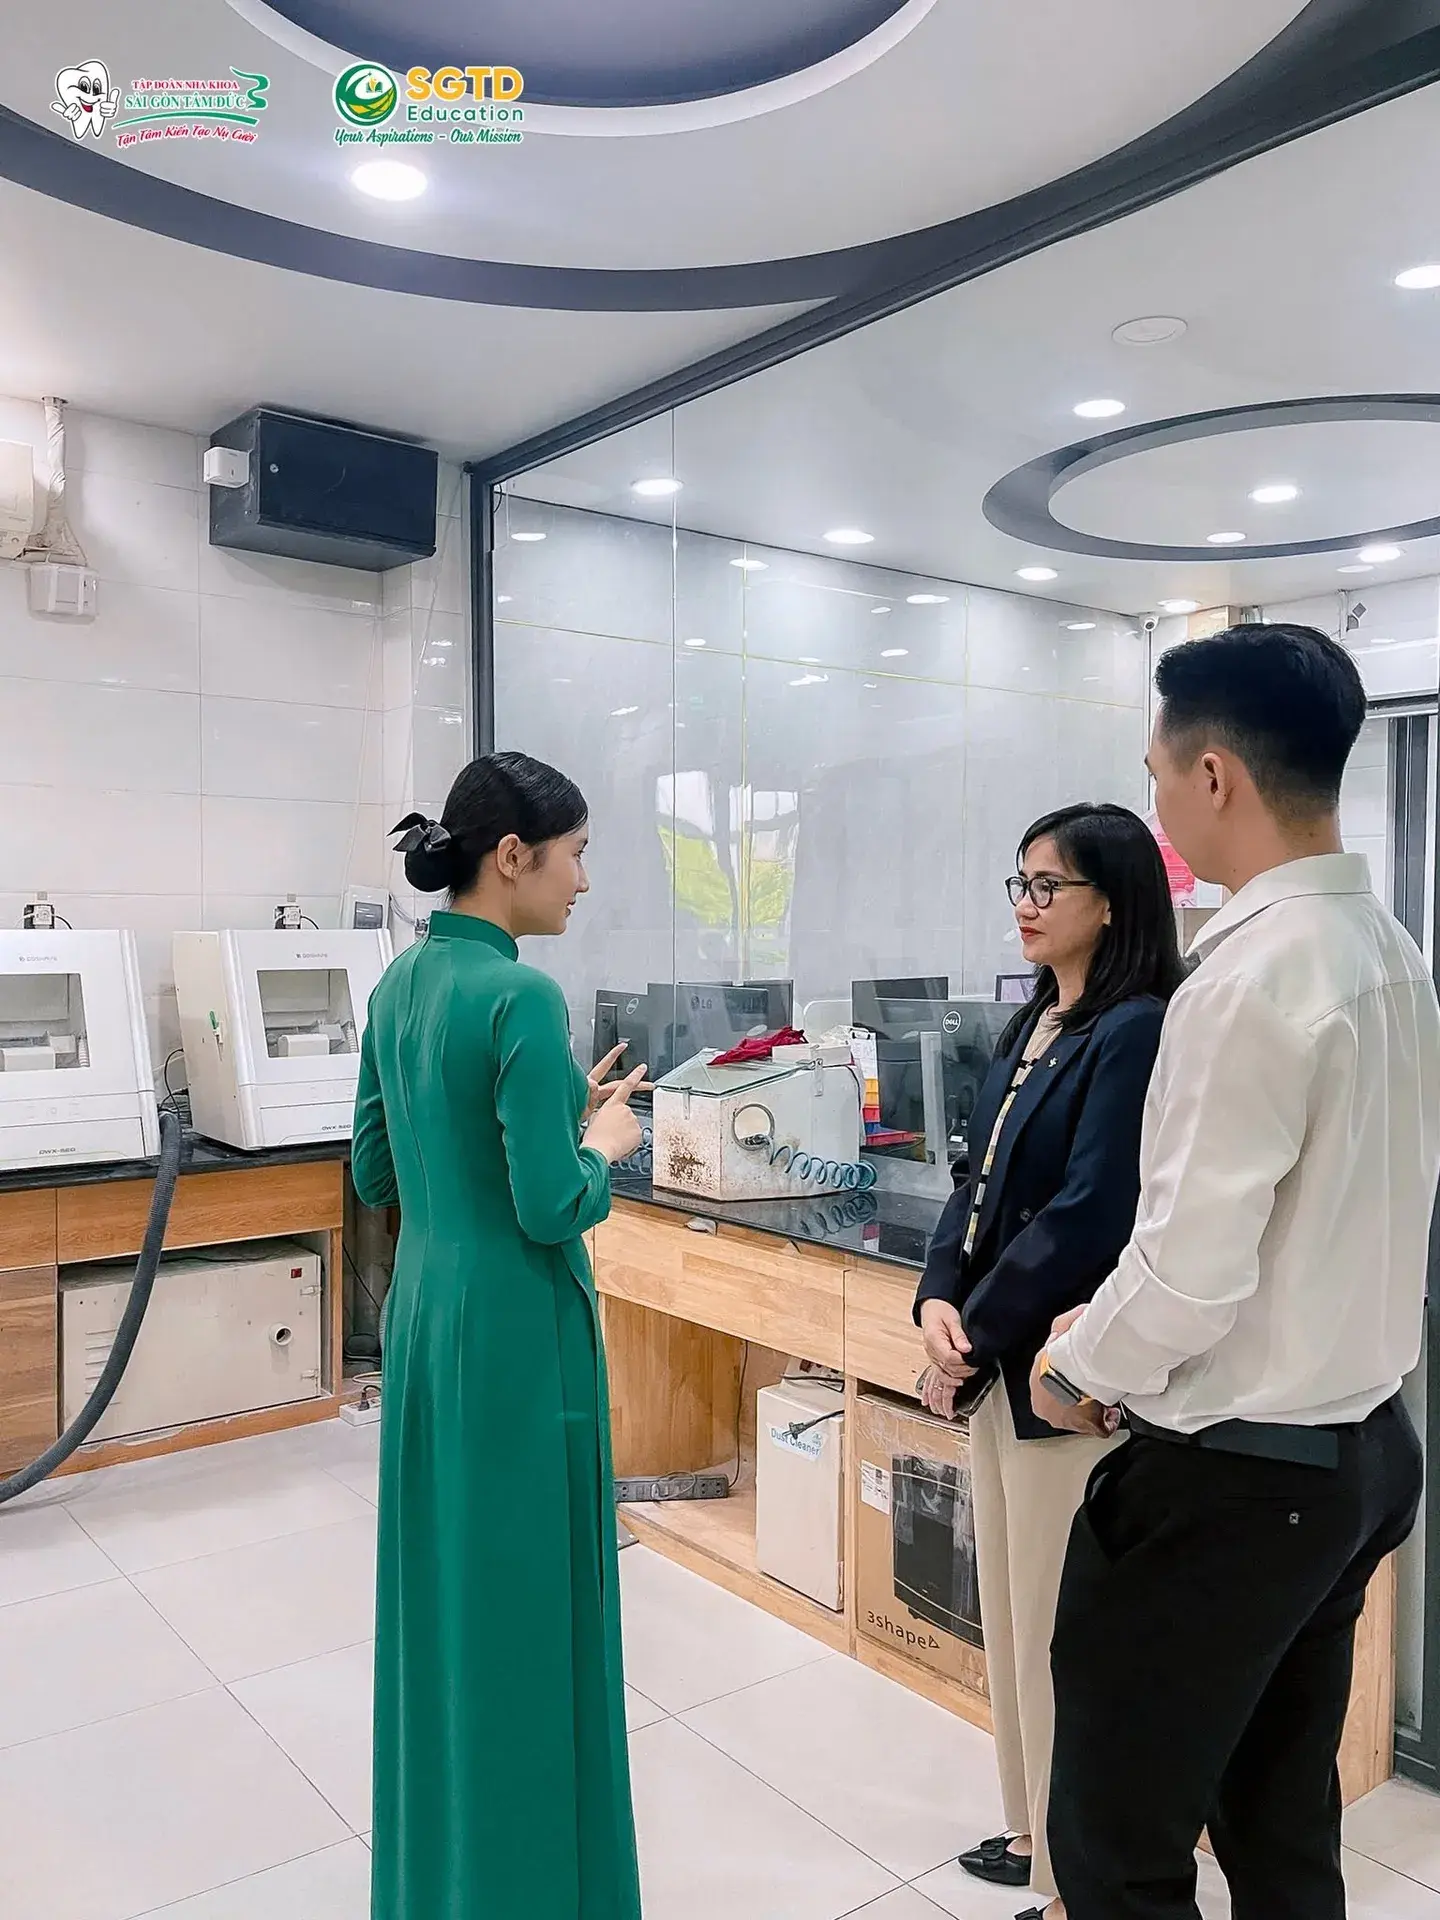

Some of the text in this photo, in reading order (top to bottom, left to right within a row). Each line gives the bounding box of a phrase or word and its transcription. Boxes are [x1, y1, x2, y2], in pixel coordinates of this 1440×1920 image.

[771, 1428, 789, 1443] Dust
[789, 1436, 820, 1455] Cleaner
[867, 1610, 927, 1650] 3shape
